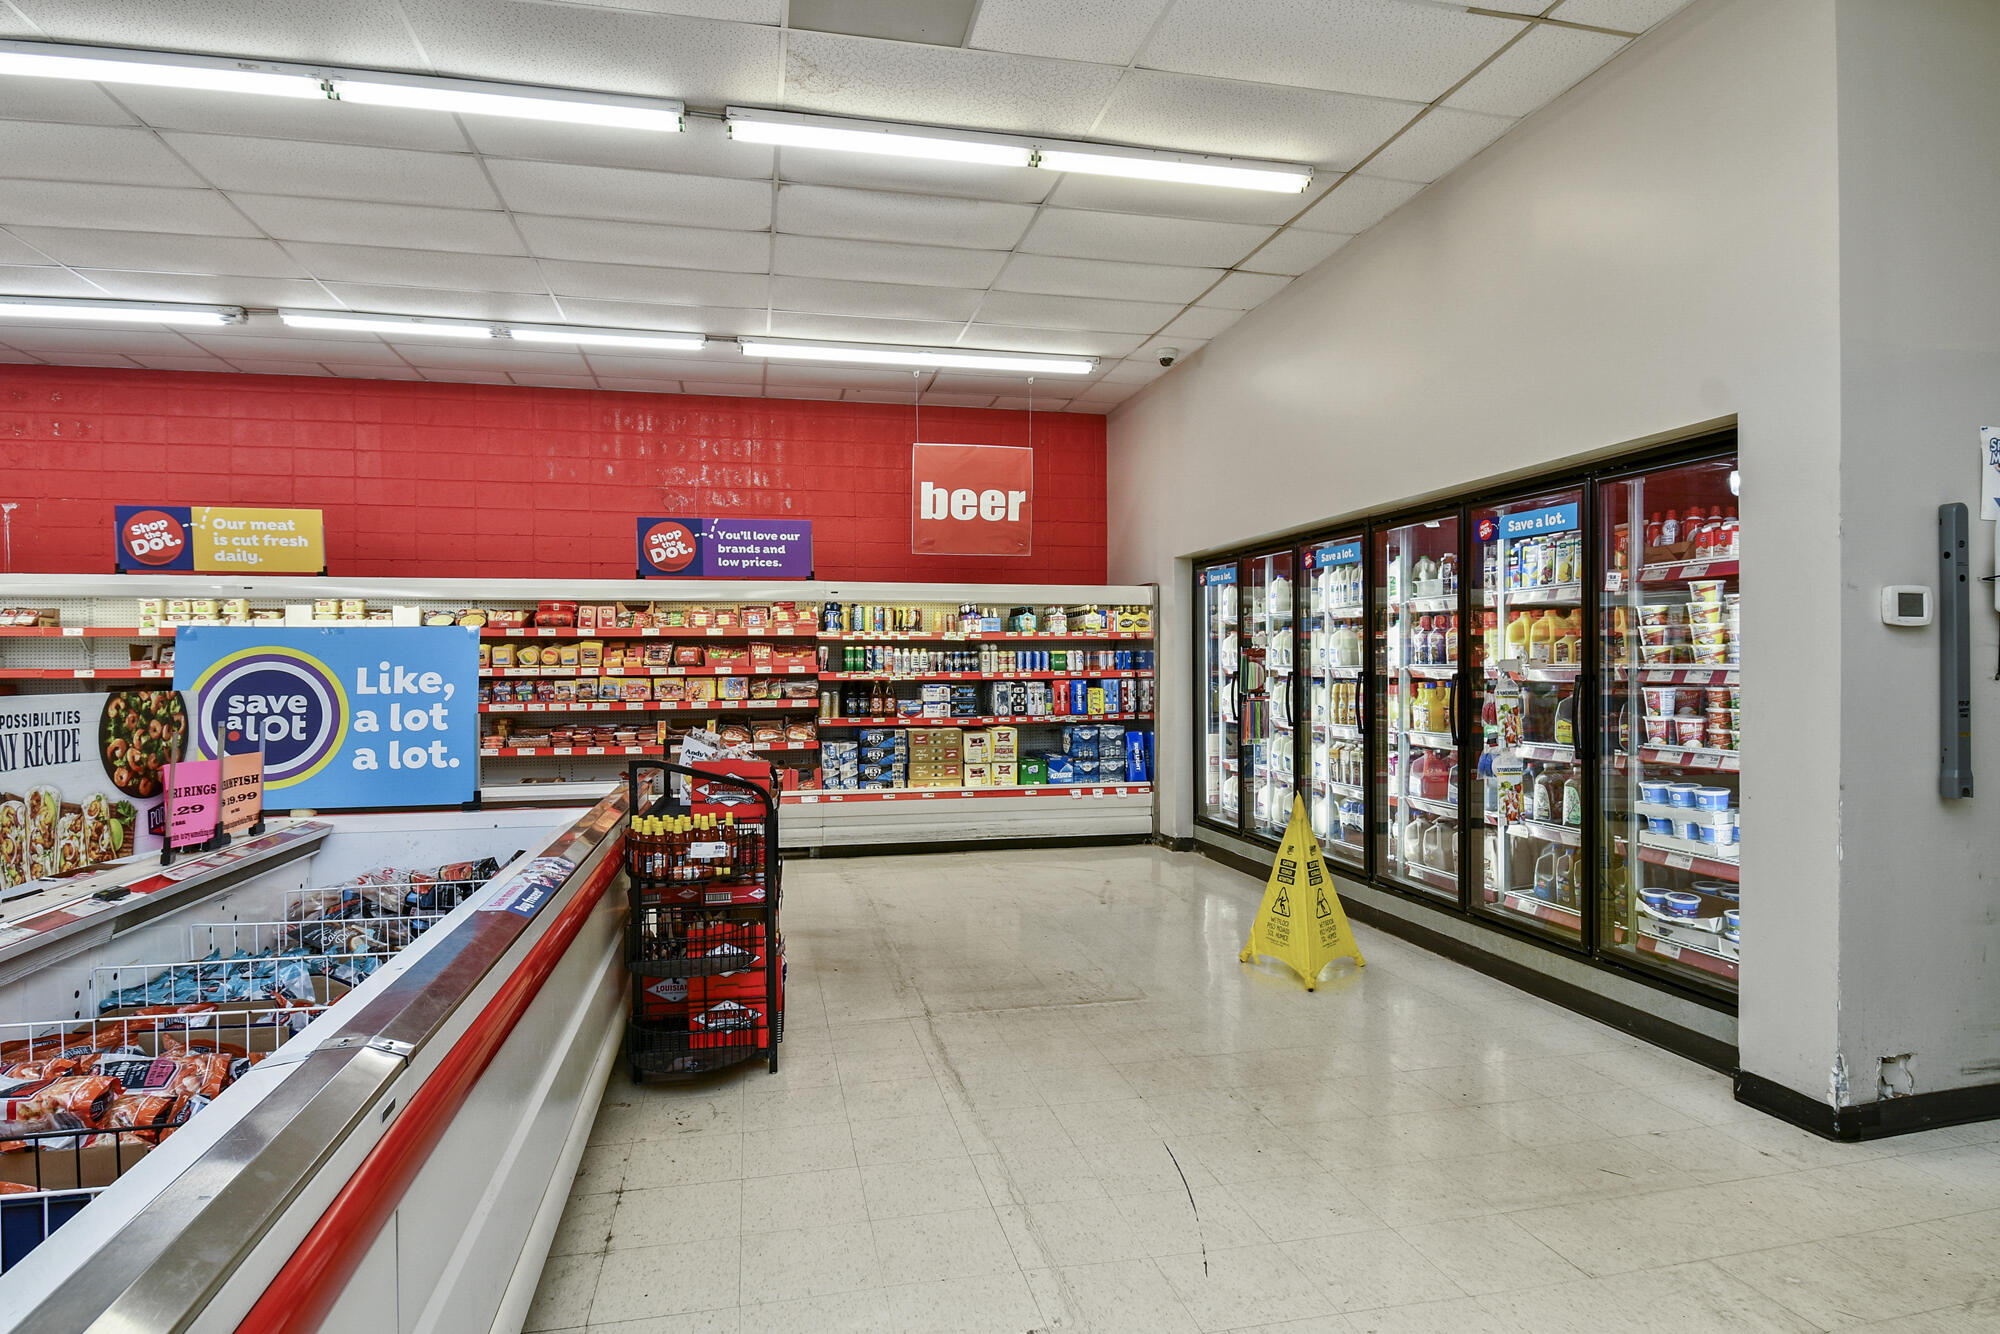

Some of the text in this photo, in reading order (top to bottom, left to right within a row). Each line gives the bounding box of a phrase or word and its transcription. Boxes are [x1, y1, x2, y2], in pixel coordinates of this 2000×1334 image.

[920, 482, 1026, 522] beer
[131, 519, 168, 536] Shop
[213, 518, 296, 531] Our meat
[1508, 512, 1566, 532] Save a lot.
[144, 530, 161, 540] the
[214, 533, 308, 547] is cut fresh
[650, 529, 682, 544] Shop
[718, 530, 800, 542] You'll love our
[131, 531, 181, 556] Dot.
[662, 540, 676, 548] the
[718, 544, 786, 554] brands and
[214, 549, 263, 564] daily.
[650, 541, 692, 563] Dot.
[1322, 553, 1336, 562] Save
[1342, 549, 1354, 559] lot.
[718, 557, 782, 570] low prices.
[357, 661, 455, 701] Like,
[228, 694, 307, 714] save
[354, 703, 448, 732] a lot
[226, 715, 307, 742] a lot
[23, 728, 80, 769] RECIPE
[352, 740, 460, 770] a lot.
[686, 748, 708, 758] Andy's
[184, 784, 216, 796] RINGS
